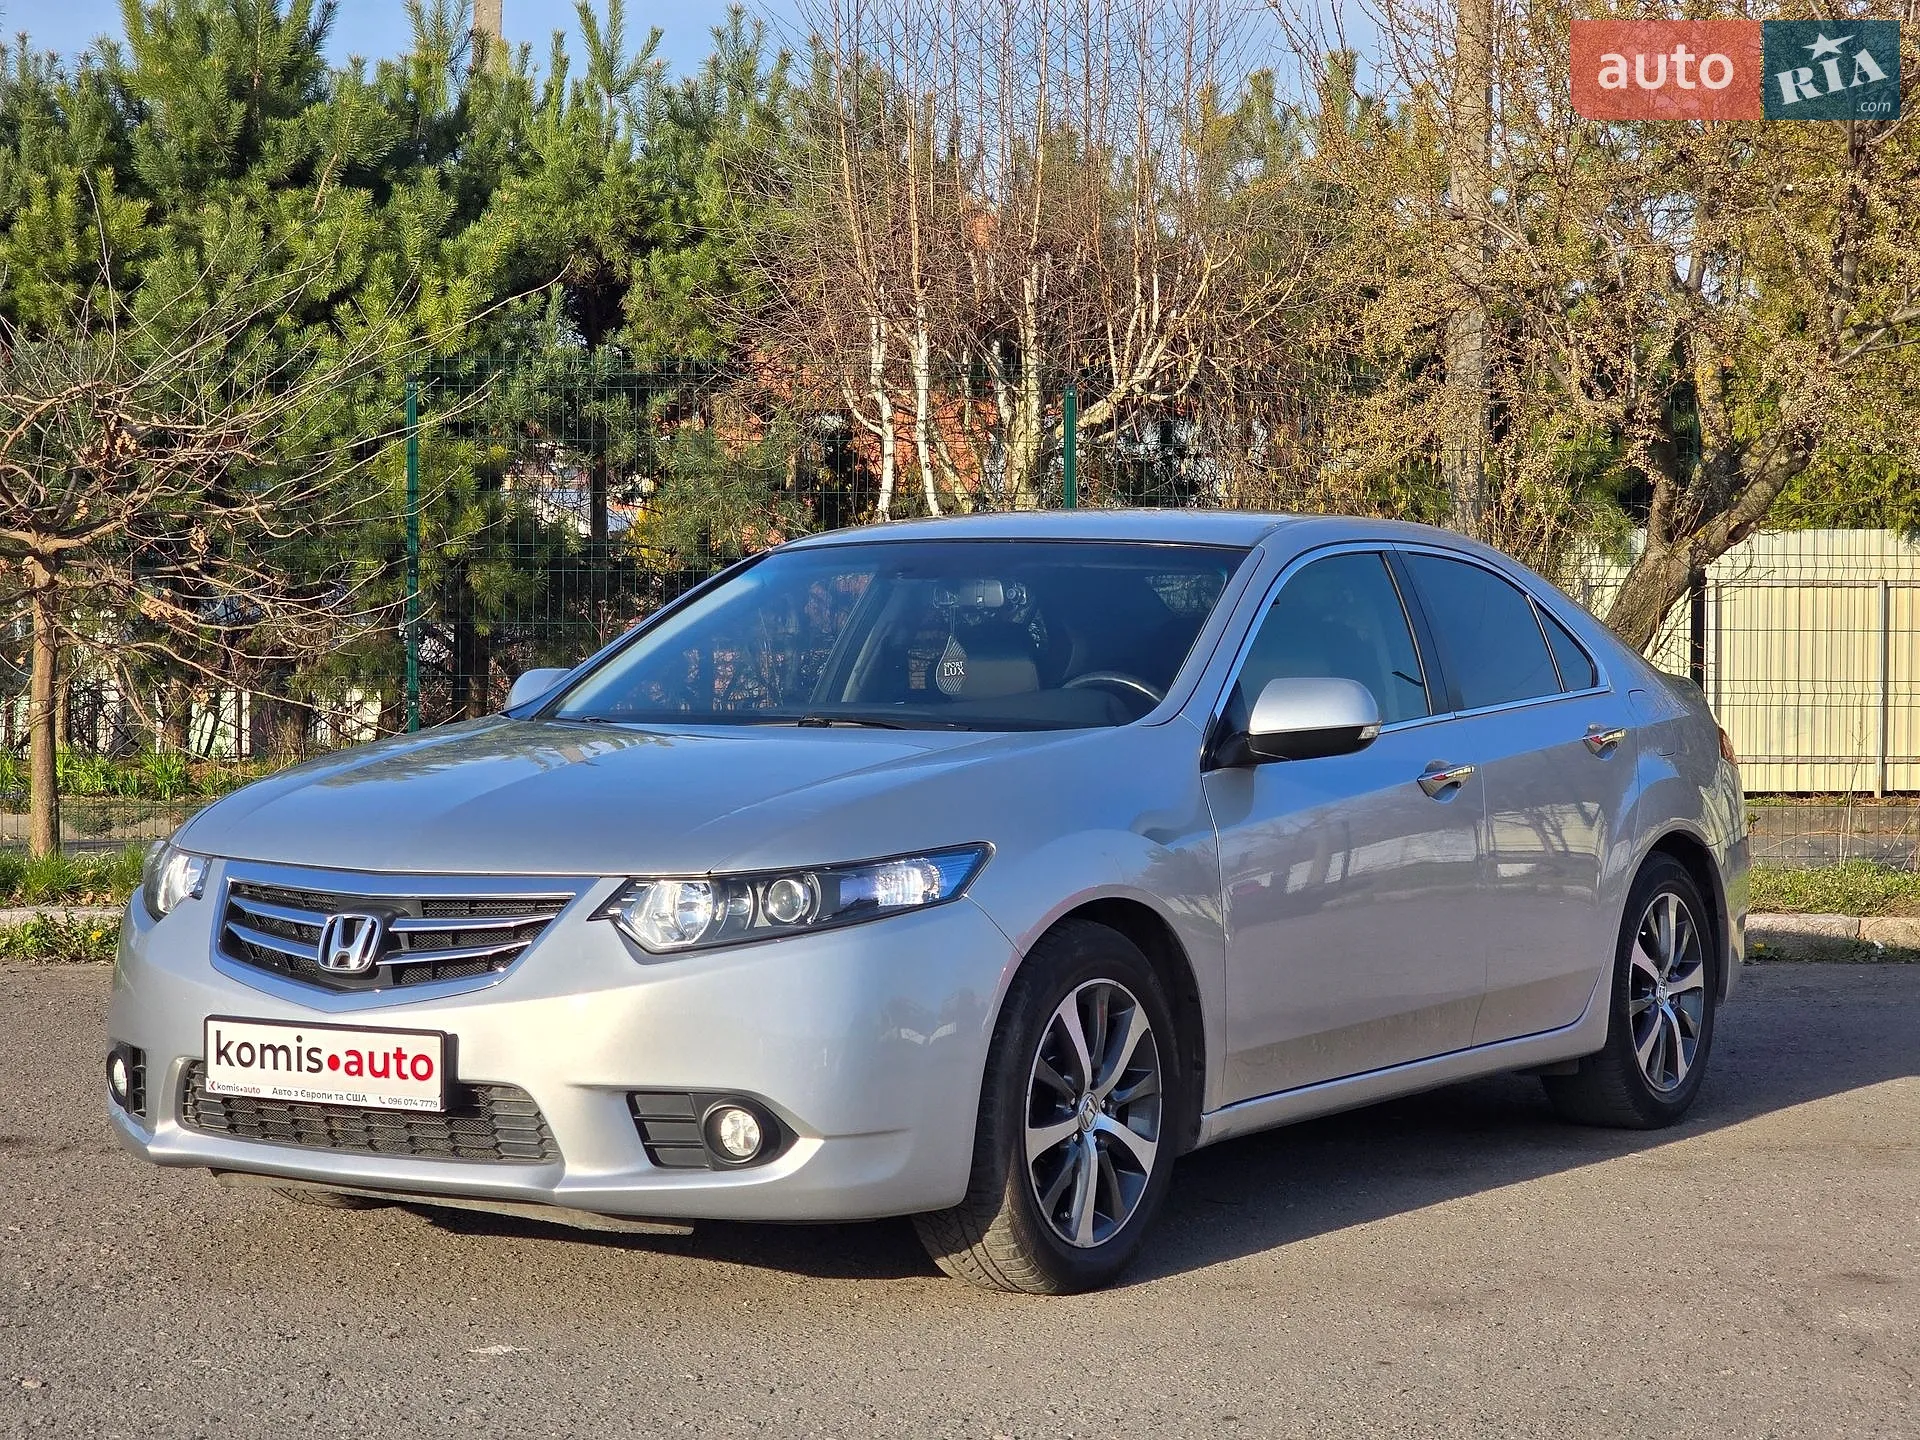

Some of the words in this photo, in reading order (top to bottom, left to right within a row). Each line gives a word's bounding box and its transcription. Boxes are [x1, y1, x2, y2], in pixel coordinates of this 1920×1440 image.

[944, 667, 964, 676] LUX
[272, 1087, 293, 1097] Авто
[300, 1089, 333, 1102] Європи
[334, 1092, 344, 1101] та
[346, 1092, 368, 1103] США
[388, 1097, 403, 1105] 096
[403, 1098, 419, 1107] 074
[420, 1099, 438, 1108] 7779
